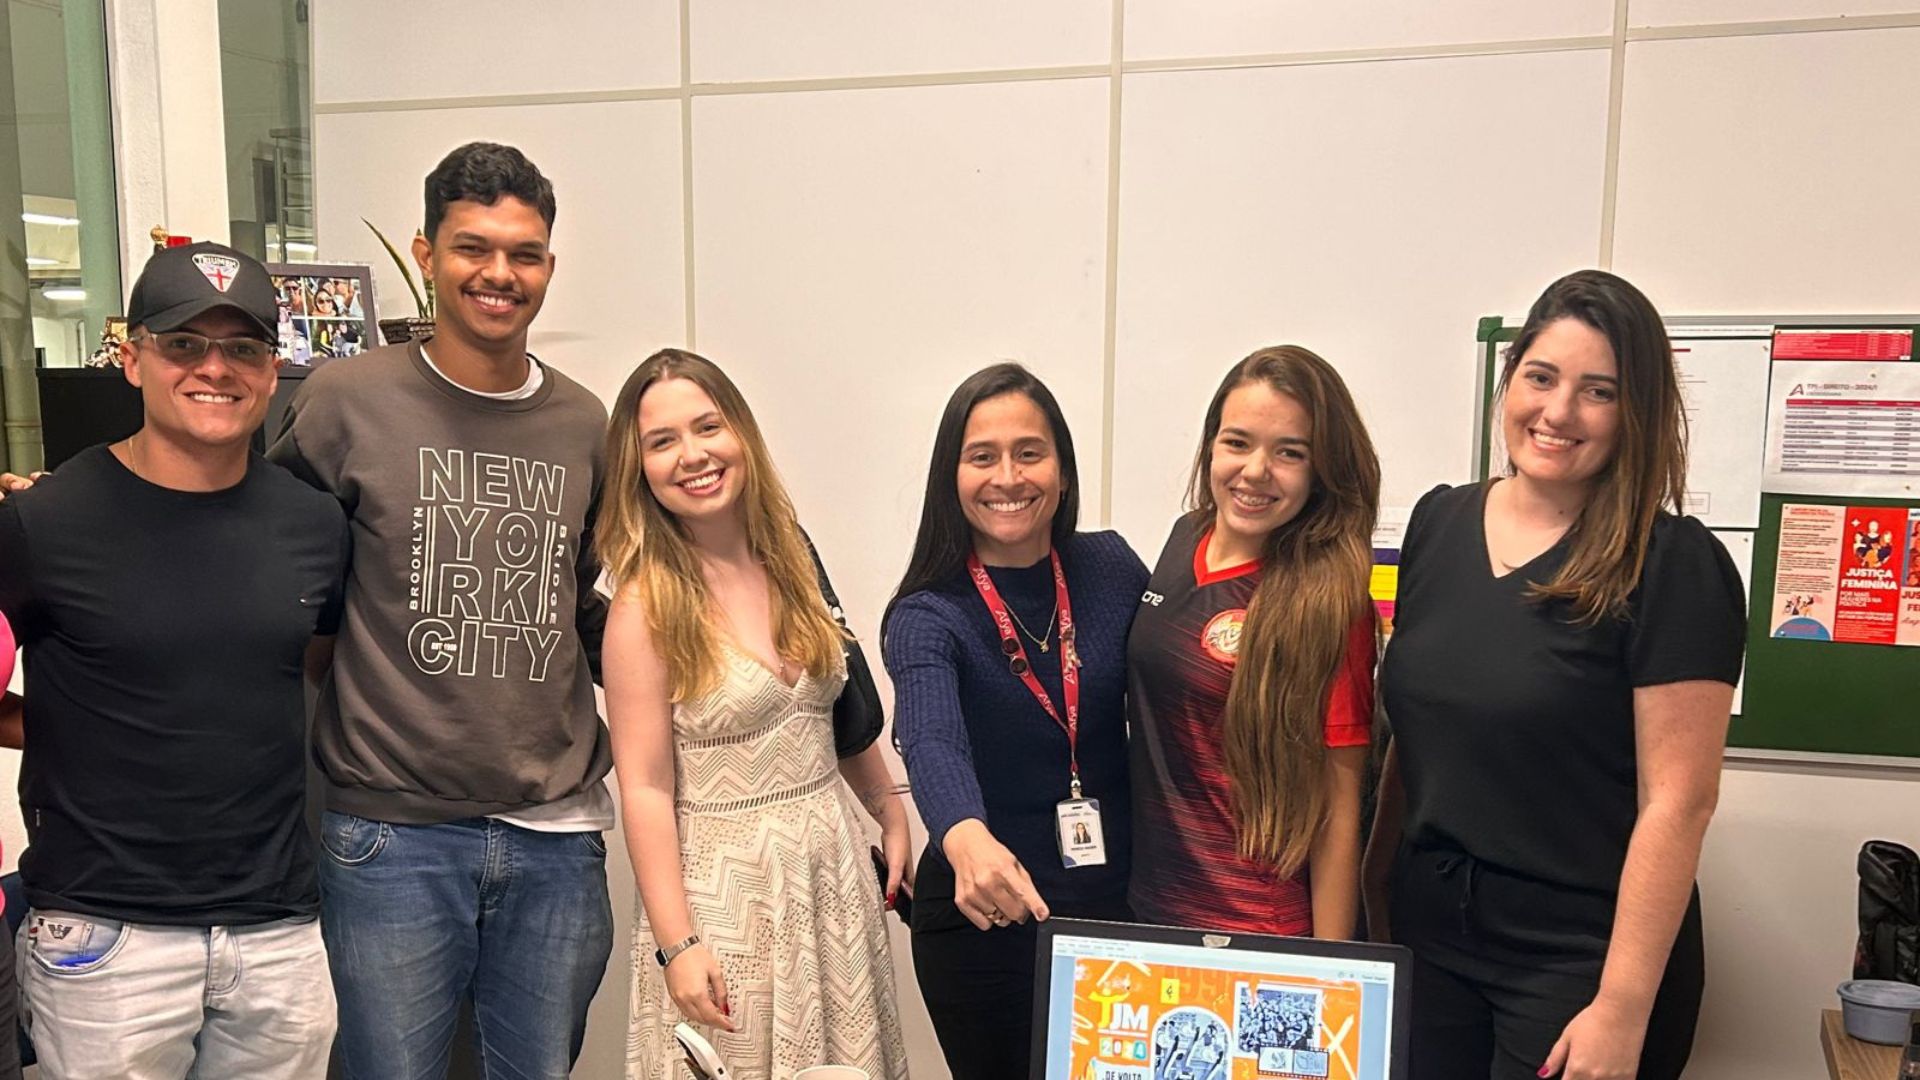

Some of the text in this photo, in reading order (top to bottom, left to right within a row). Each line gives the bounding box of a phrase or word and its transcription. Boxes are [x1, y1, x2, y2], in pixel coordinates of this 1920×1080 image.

[419, 447, 566, 516] NEW
[409, 506, 424, 611] BROOKLYN
[1841, 579, 1898, 590] FEMININA
[1845, 568, 1893, 580] JUSTIÇA
[407, 618, 562, 682] CITY
